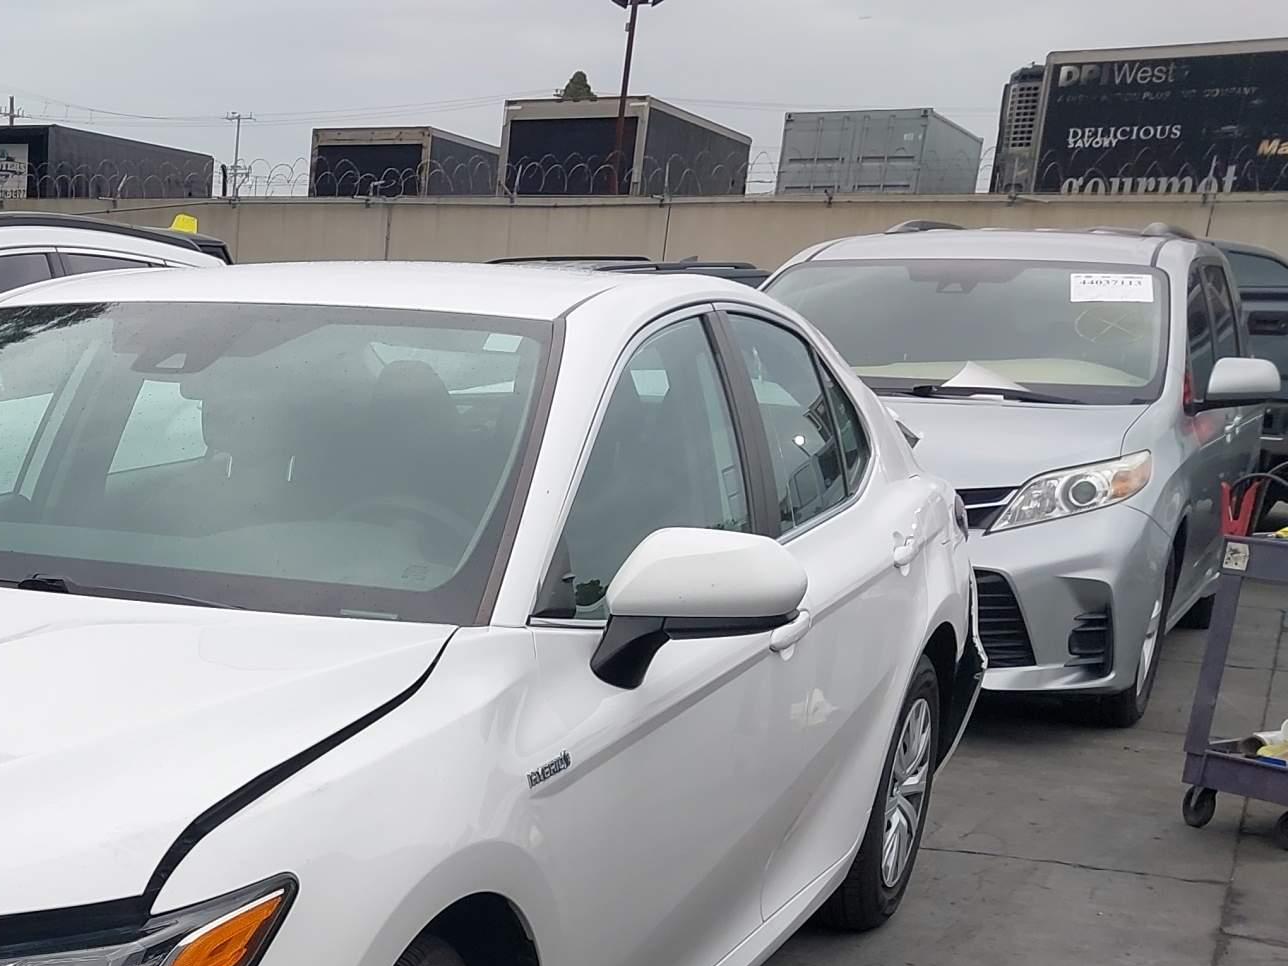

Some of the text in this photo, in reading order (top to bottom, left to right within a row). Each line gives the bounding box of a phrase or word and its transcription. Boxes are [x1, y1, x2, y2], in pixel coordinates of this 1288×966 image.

[1058, 62, 1176, 87] DPI West
[1068, 125, 1182, 142] DELICIOUS
[1067, 137, 1120, 148] SAVORY
